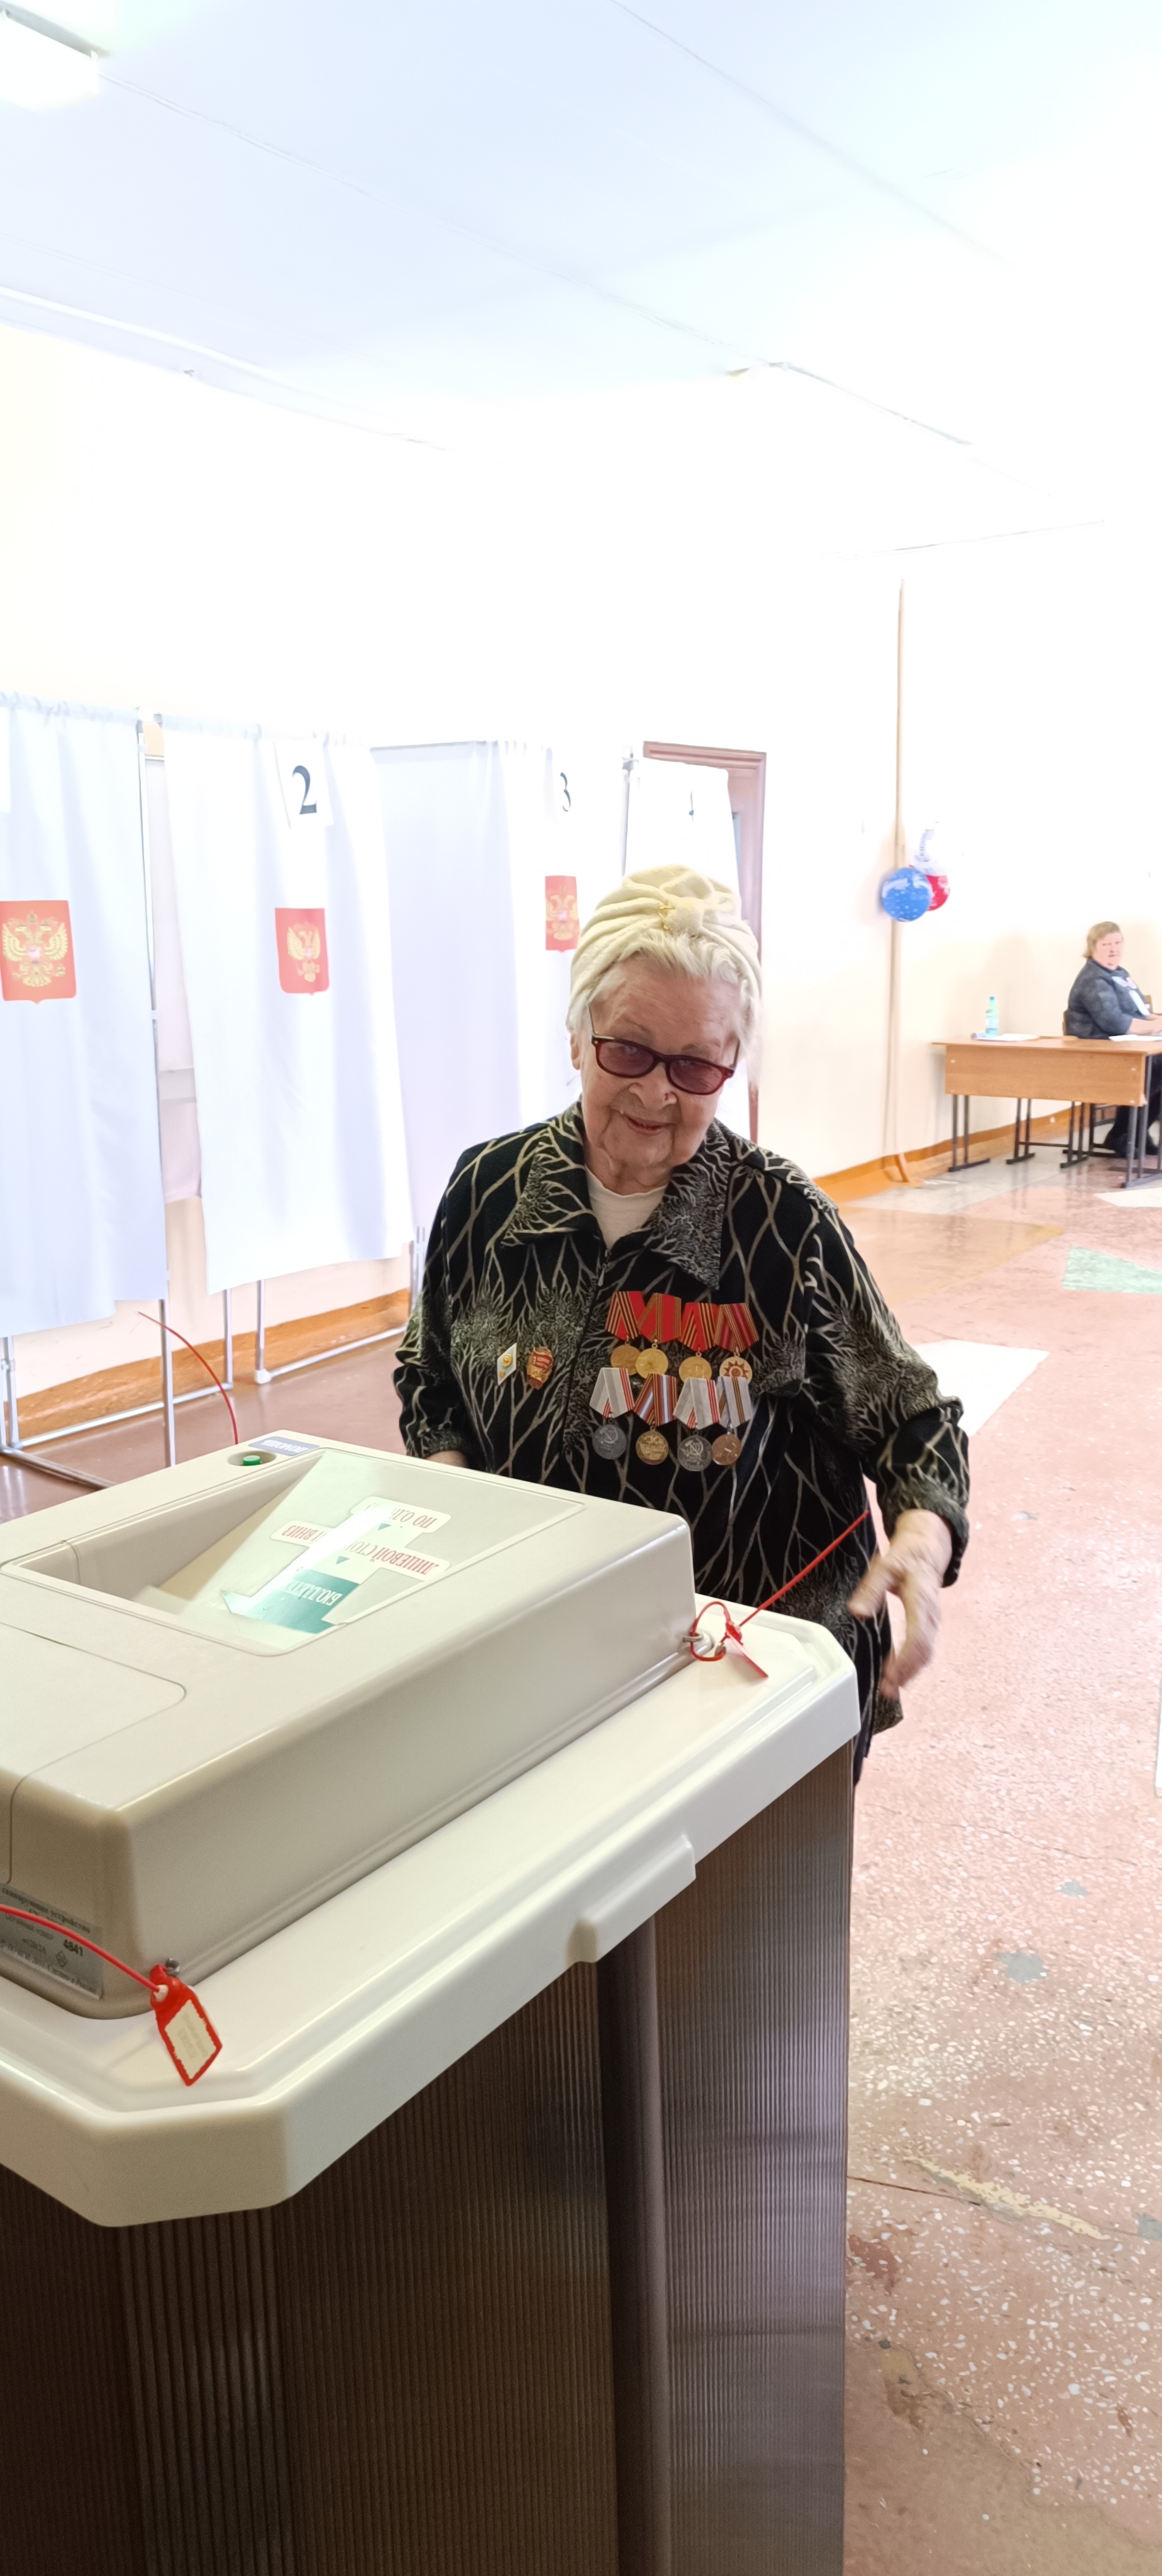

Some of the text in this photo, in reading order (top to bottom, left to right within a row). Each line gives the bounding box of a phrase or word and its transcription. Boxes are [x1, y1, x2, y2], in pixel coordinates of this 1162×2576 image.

[292, 765, 318, 815] 2
[282, 1525, 314, 1541] ВНИЗ
[412, 1515, 438, 1529] ПО
[369, 1546, 440, 1575] ЛИЦЕВОЙ
[282, 1580, 343, 1606] БЮЛЛЕТЕ
[64, 1939, 83, 1957] 4841
